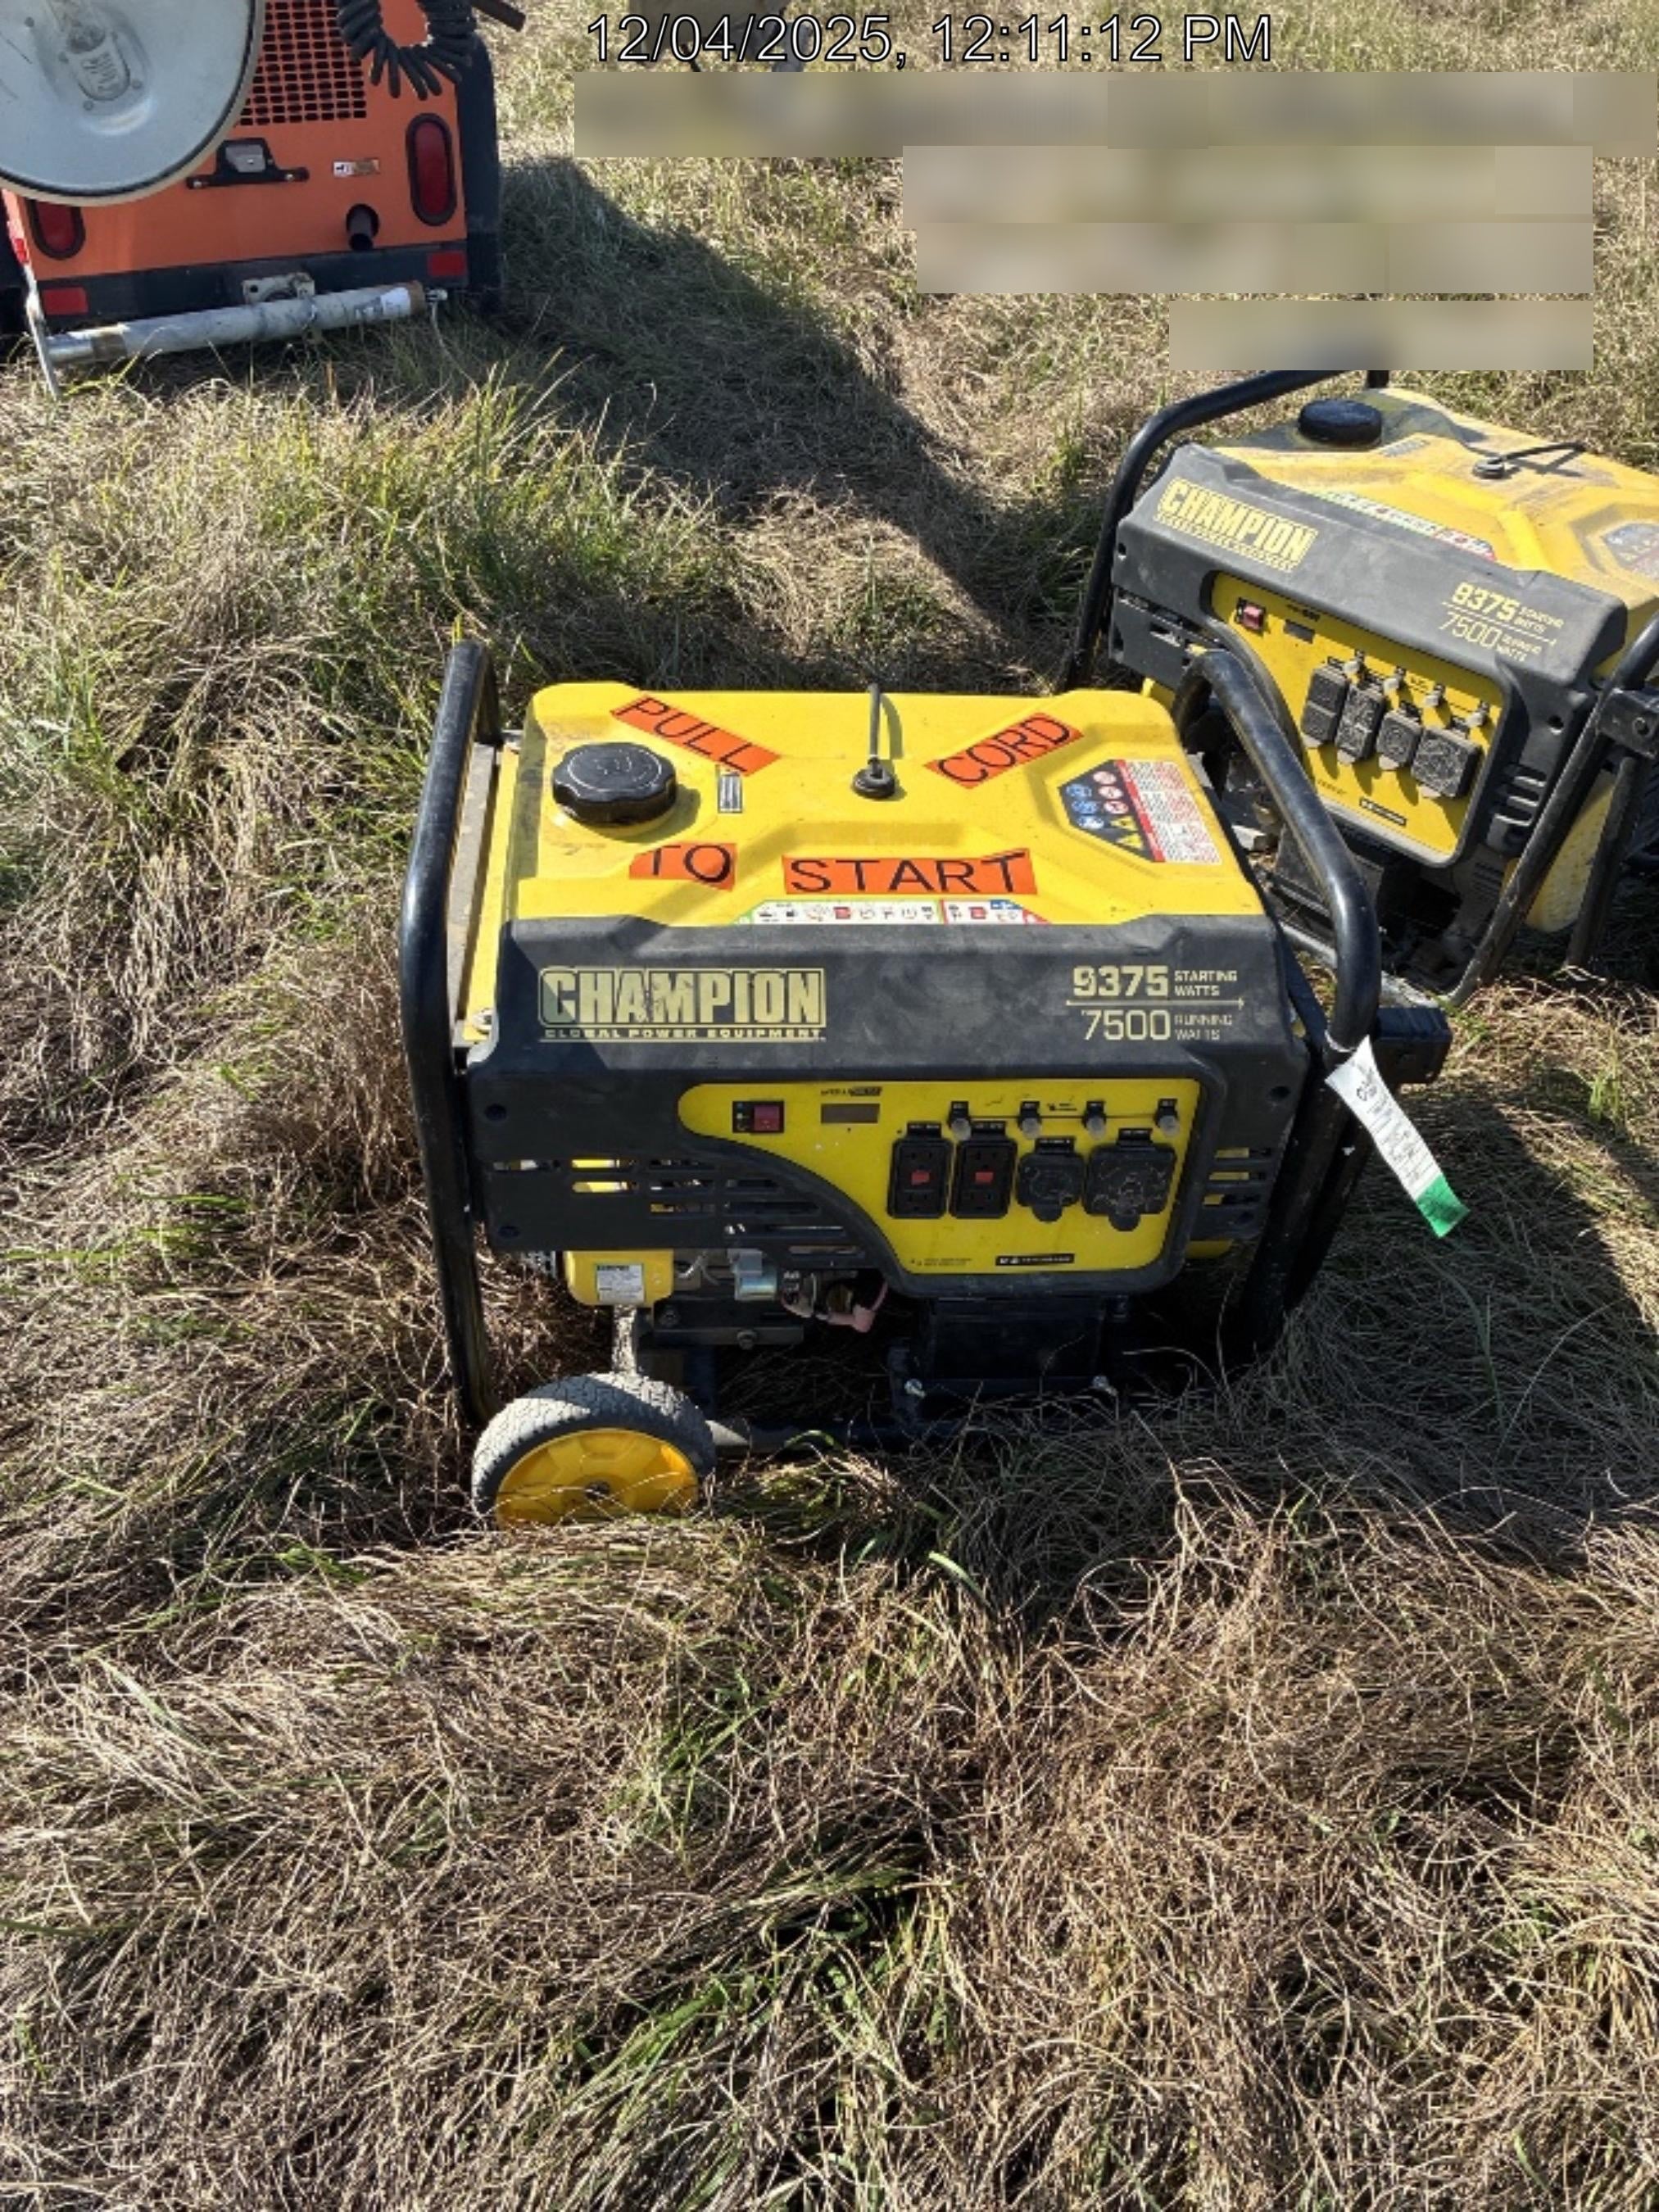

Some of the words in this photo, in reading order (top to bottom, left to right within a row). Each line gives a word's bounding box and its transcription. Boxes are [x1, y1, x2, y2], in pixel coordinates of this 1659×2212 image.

[1159, 478, 1315, 563] CHAMPION
[1438, 611, 1503, 649] 7500
[614, 696, 754, 773] PULL
[938, 715, 1071, 785] CORD
[645, 844, 732, 883] TO
[791, 850, 1027, 893] START
[1072, 965, 1169, 998] 9375
[1174, 970, 1237, 982] STARTING
[1174, 985, 1220, 996] WATTS
[541, 969, 823, 1024] CHAMPION
[628, 1028, 696, 1038] POWER
[707, 1028, 821, 1038] EQUIPMENT
[1081, 1009, 1172, 1041] 7500
